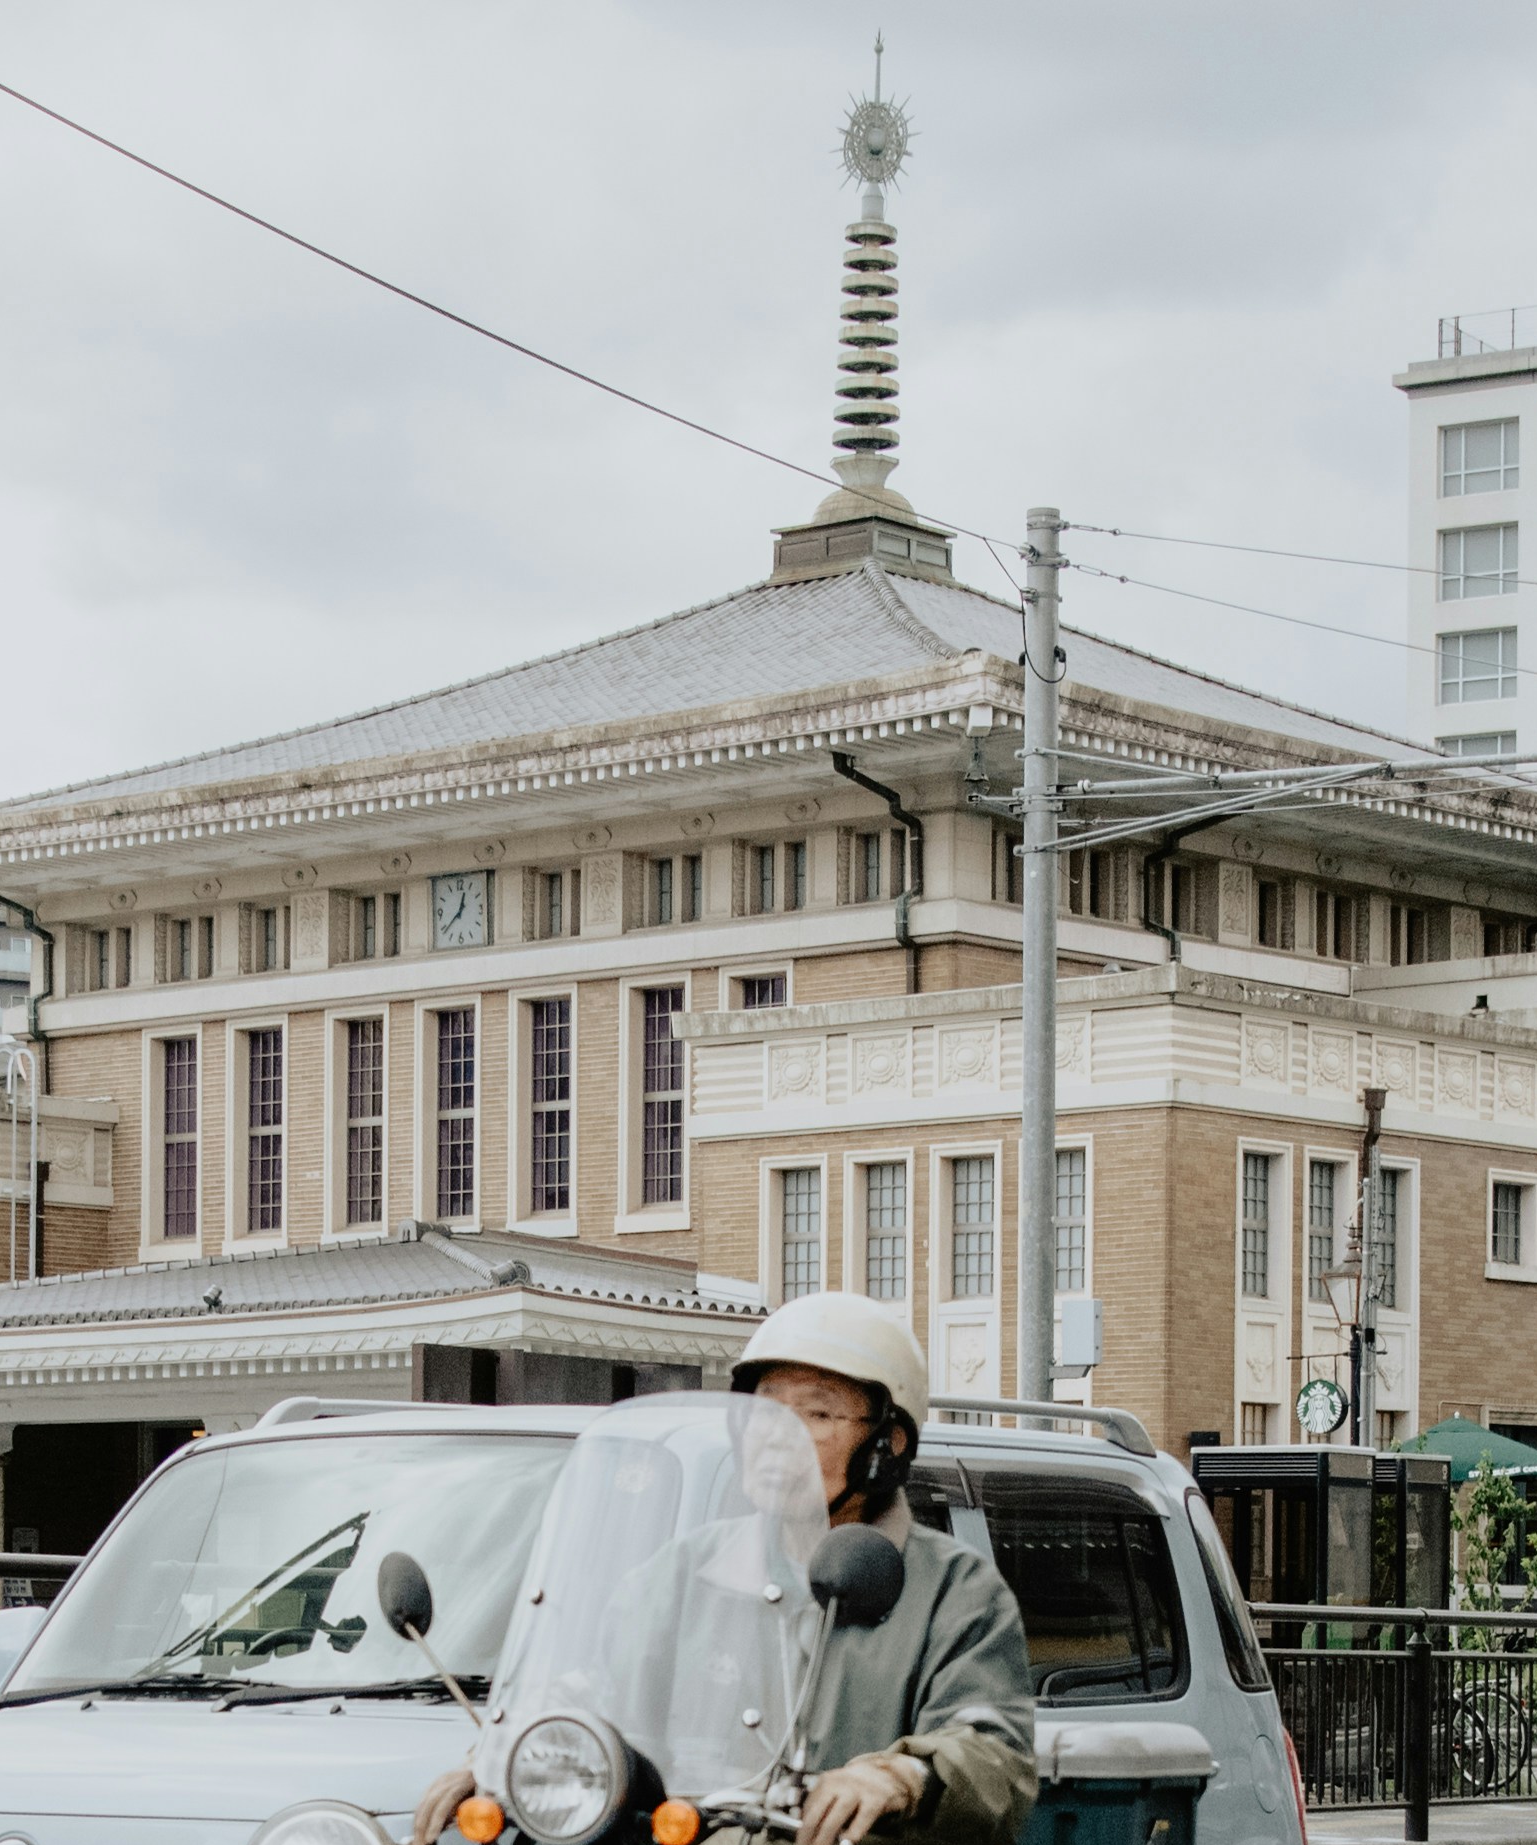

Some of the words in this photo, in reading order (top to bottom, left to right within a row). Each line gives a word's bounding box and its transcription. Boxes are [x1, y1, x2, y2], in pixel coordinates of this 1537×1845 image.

[456, 879, 464, 891] 12
[437, 908, 443, 920] 9
[478, 904, 483, 915] 3
[458, 932, 464, 944] 6
